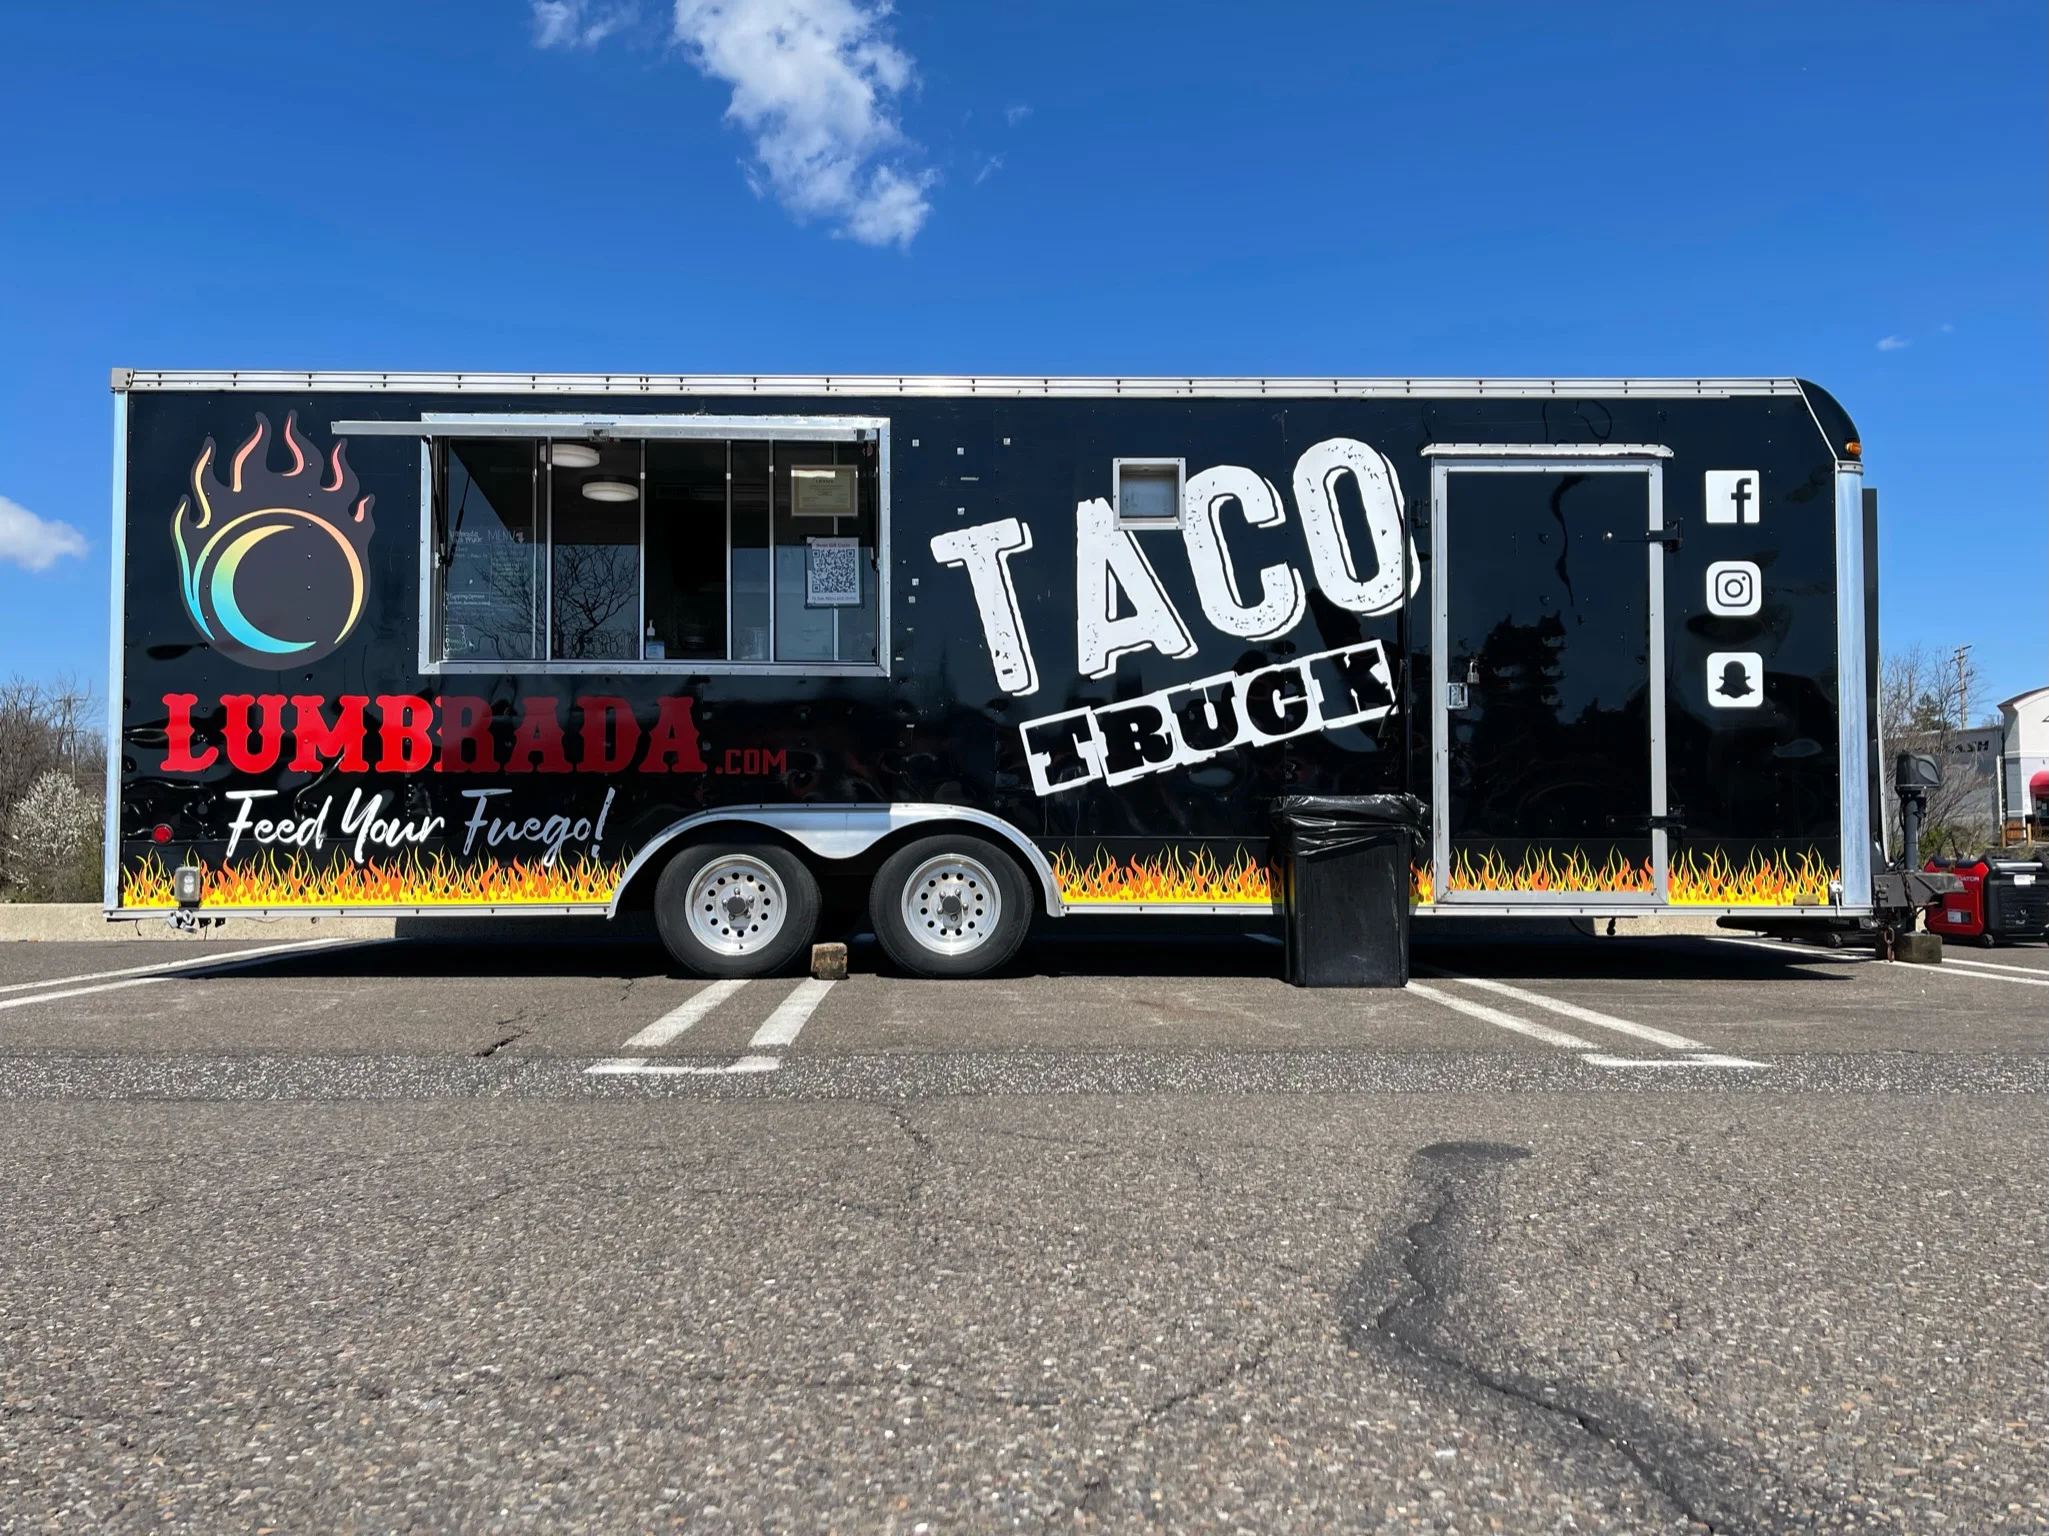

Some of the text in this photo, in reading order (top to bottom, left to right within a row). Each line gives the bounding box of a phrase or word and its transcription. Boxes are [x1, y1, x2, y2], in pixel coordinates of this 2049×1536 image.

[930, 437, 1421, 696] TACO
[1021, 641, 1397, 794] TRUCK
[225, 787, 615, 865] Feed Your Fuego!
